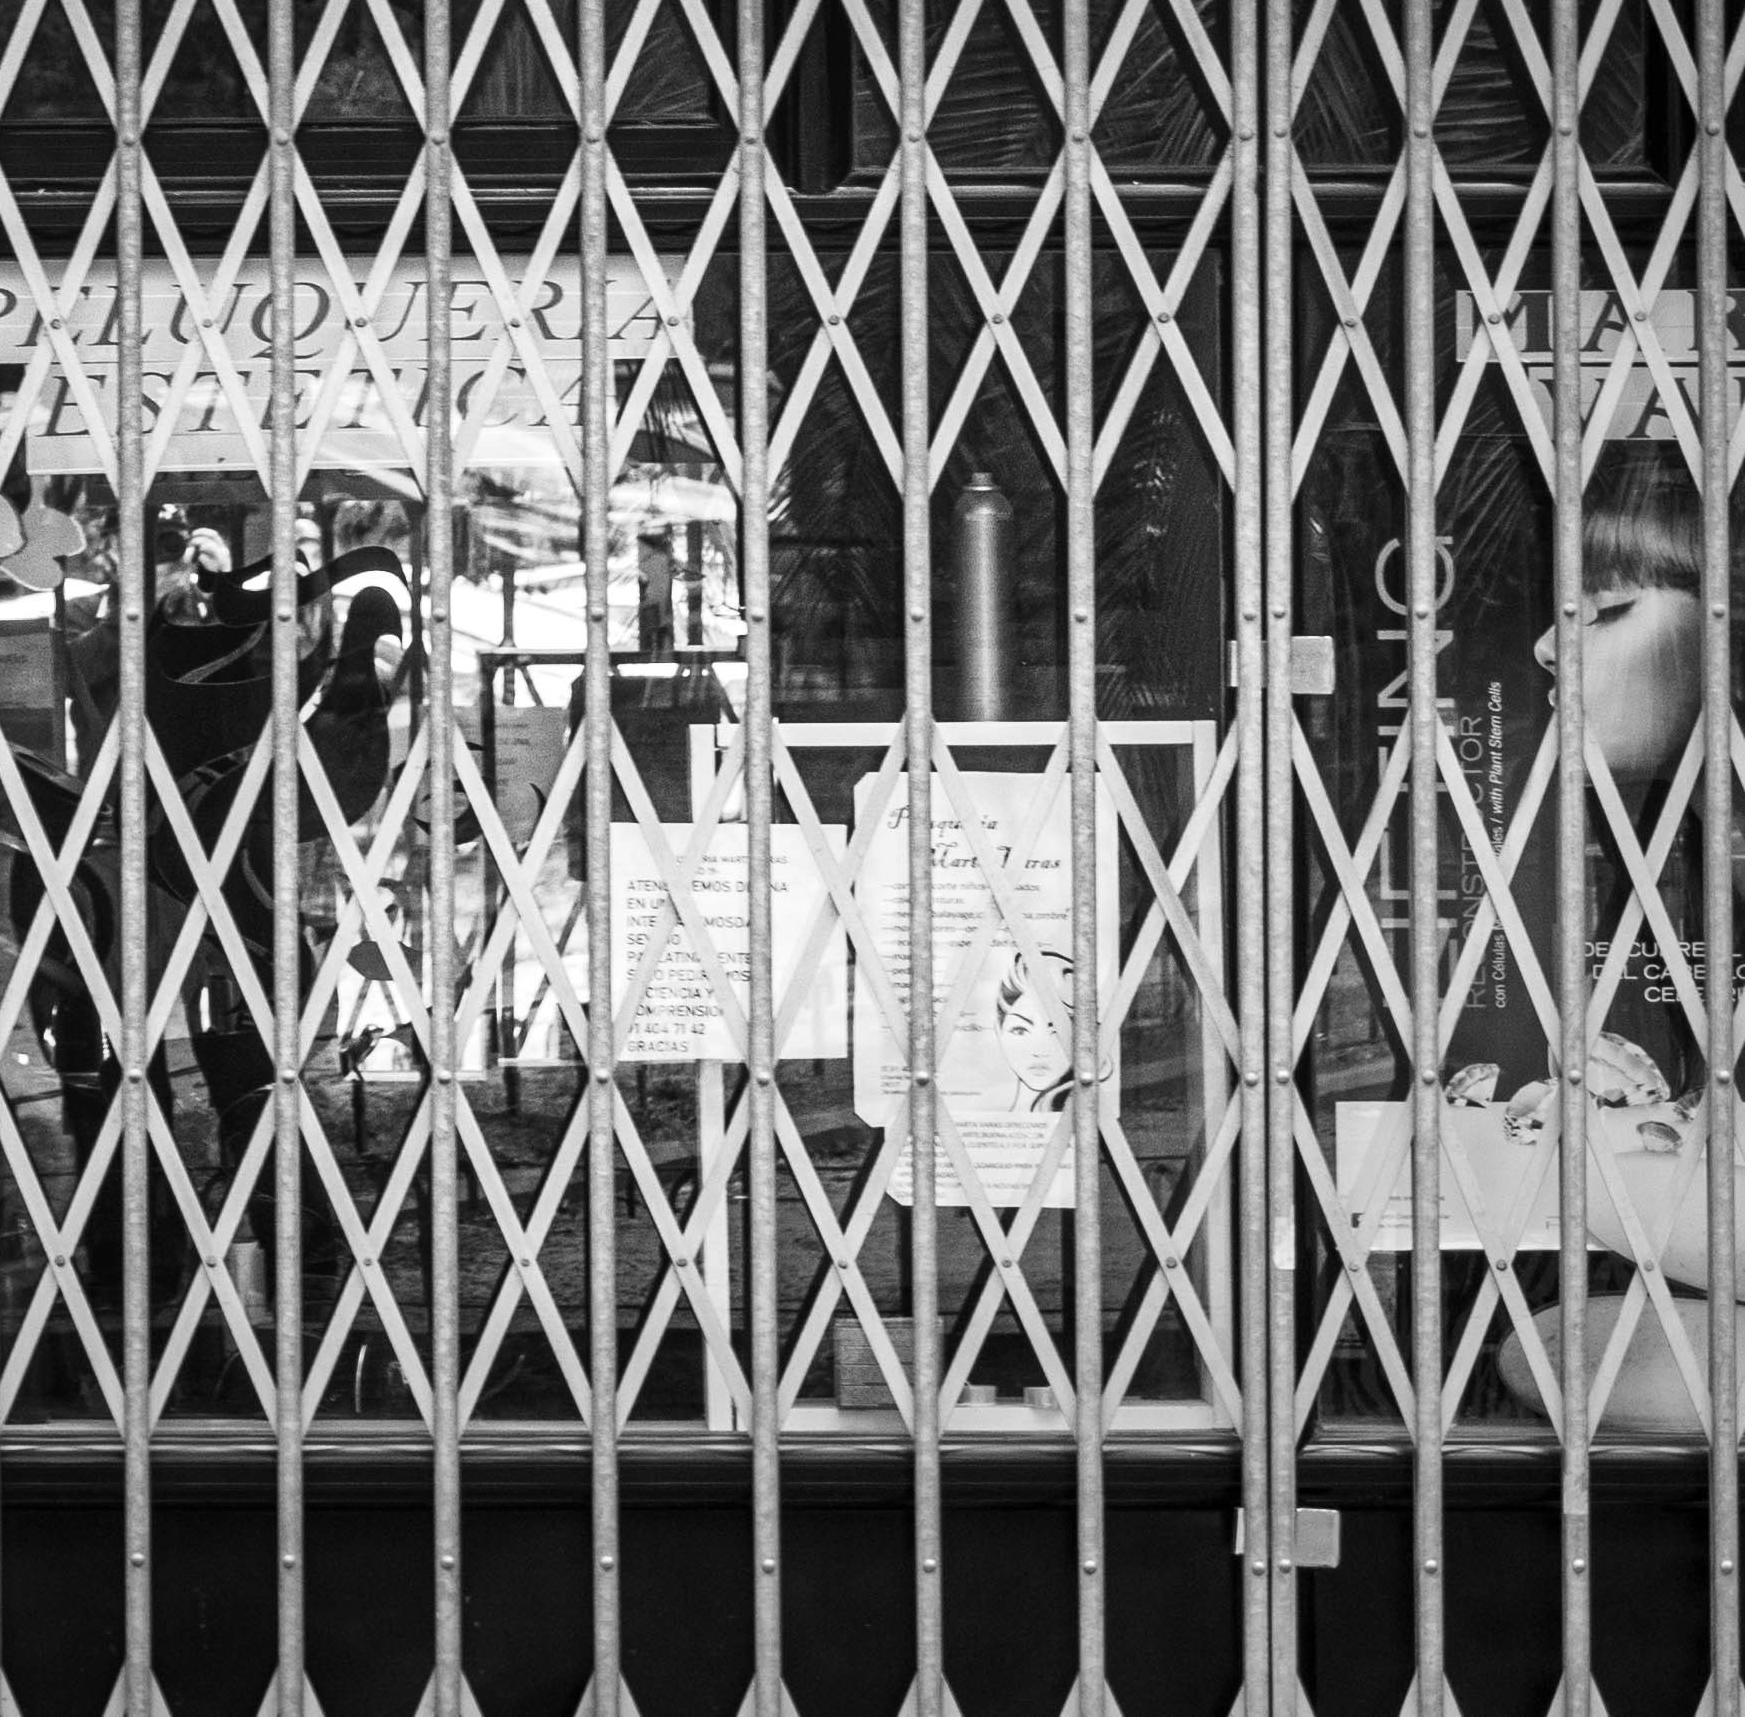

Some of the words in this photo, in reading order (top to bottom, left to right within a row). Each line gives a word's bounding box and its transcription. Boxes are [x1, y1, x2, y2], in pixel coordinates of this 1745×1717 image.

[1538, 376, 1745, 438] VA
[1487, 681, 1502, 712] Cells
[1488, 715, 1503, 749] Stem
[1488, 751, 1504, 784] Plant
[1489, 788, 1504, 814] with
[1490, 934, 1506, 980] Células
[1582, 941, 1706, 957] DECURE
[1592, 964, 1638, 980] DL
[640, 986, 702, 999] CIENCIA
[1493, 984, 1506, 1008] con
[634, 1004, 725, 1017] OMPRENSIO
[626, 1040, 690, 1053] GRACIAS
